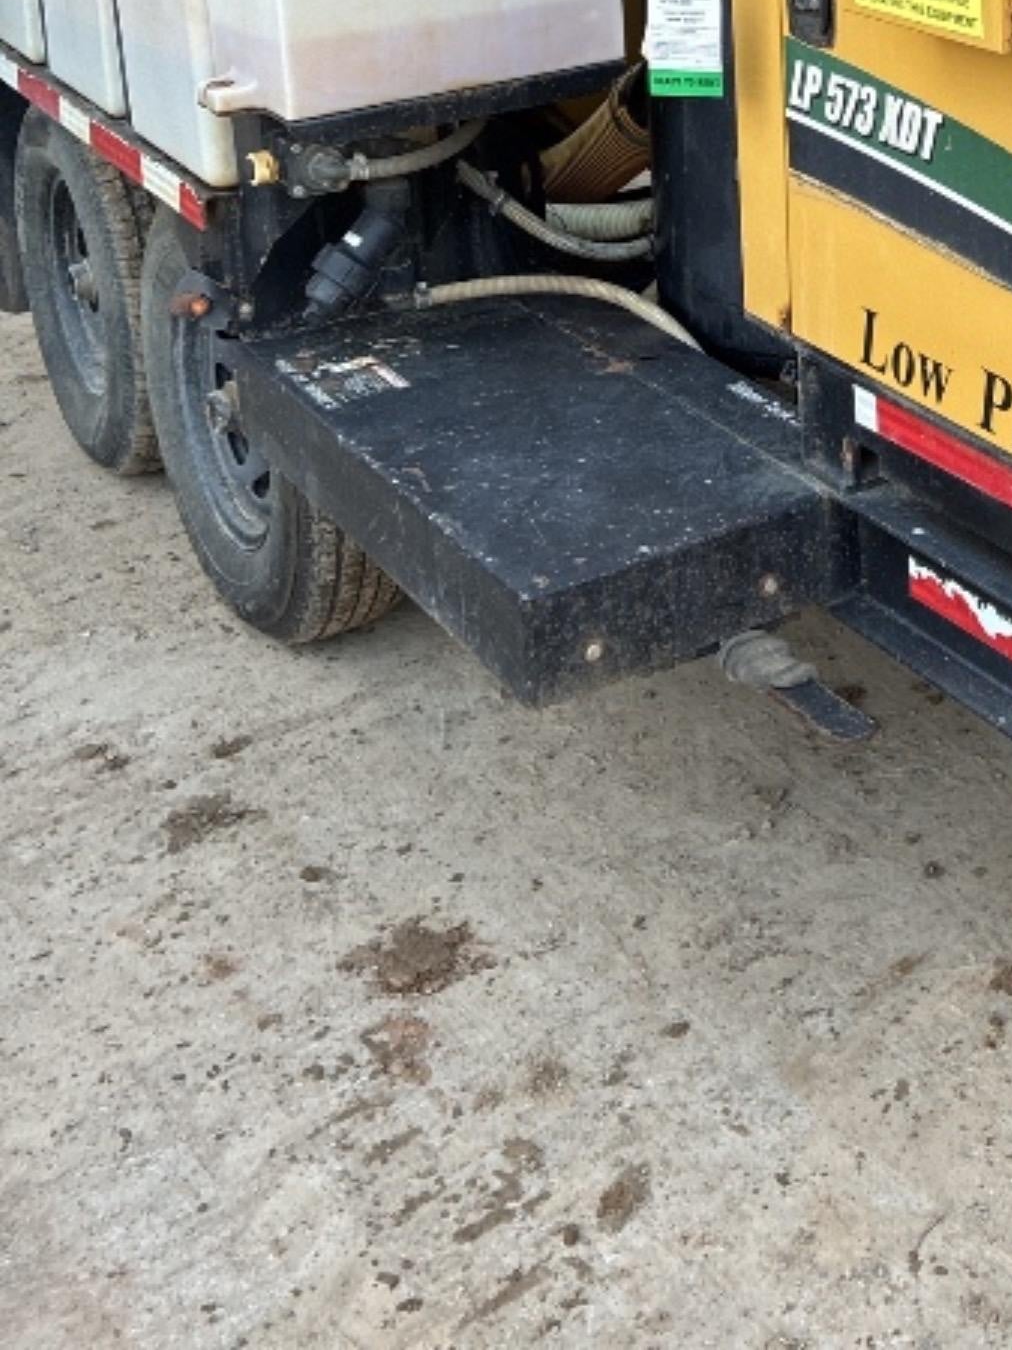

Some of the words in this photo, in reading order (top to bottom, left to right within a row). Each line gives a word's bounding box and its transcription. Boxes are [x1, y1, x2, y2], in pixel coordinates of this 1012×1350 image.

[788, 59, 823, 113] LP
[824, 71, 878, 137] 573
[860, 306, 955, 404] Low
